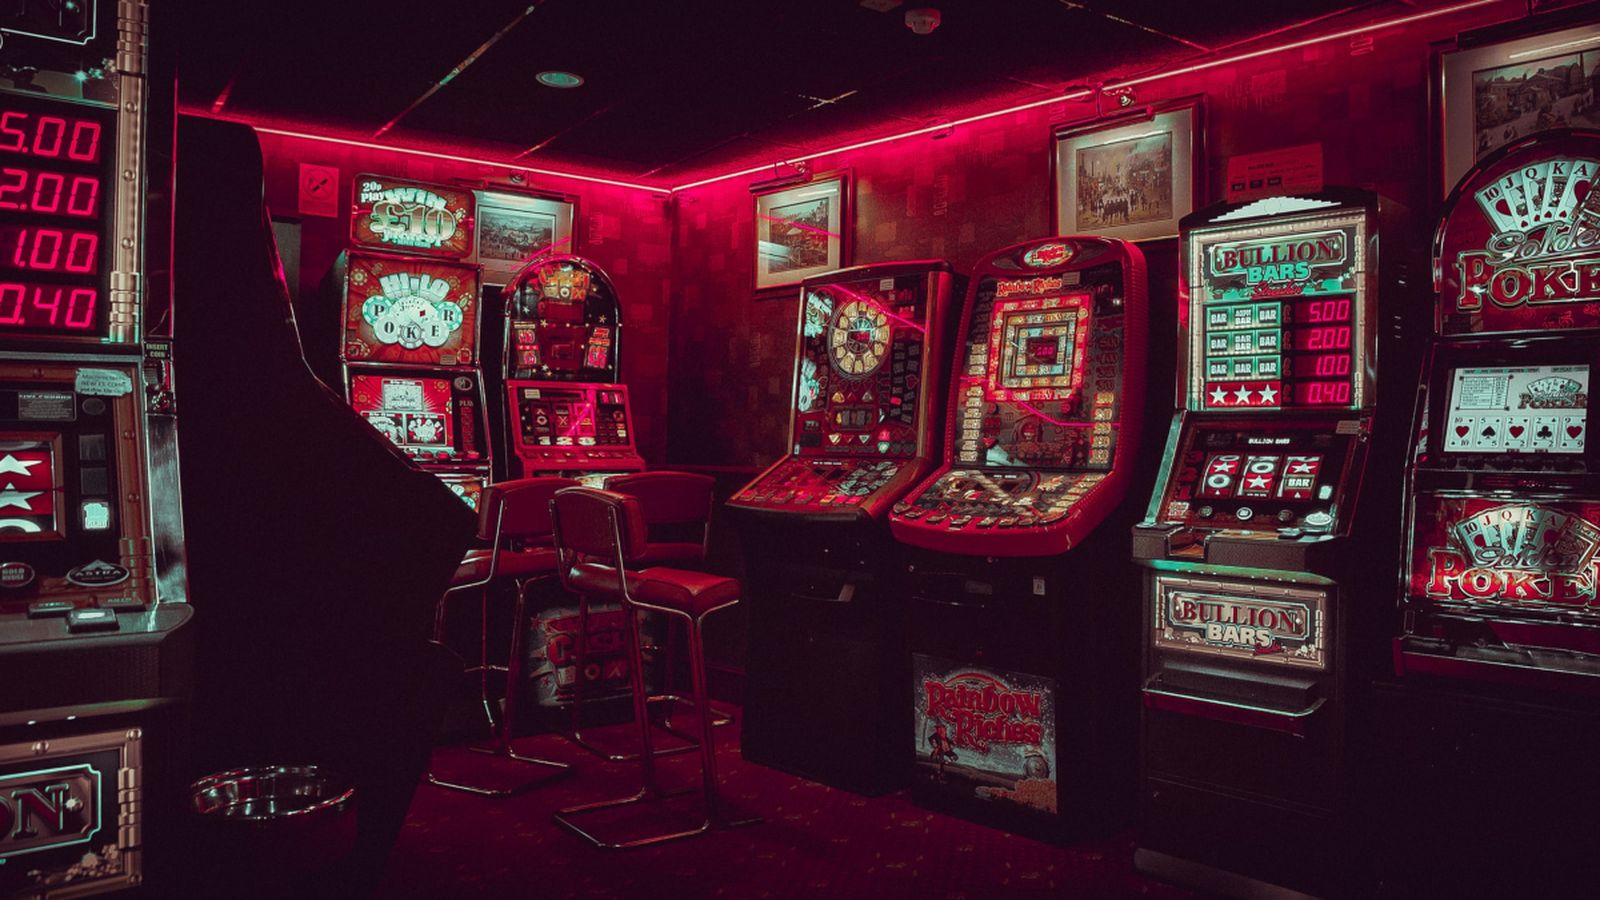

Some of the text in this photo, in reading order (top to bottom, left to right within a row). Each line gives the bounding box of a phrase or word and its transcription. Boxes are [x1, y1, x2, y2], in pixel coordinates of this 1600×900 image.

[0, 112, 101, 162] 5.00
[0, 168, 99, 216] 2.00
[384, 187, 447, 210] WIN
[13, 229, 98, 273] 1.00
[1486, 219, 1600, 265] Golde
[1222, 240, 1337, 268] BULLION
[1247, 261, 1310, 283] BARS
[1211, 313, 1227, 324] BAR
[1259, 310, 1277, 321] BAR
[1309, 301, 1350, 322] 5.00
[1211, 339, 1227, 349] BAR
[1235, 334, 1251, 343] BAR
[1235, 342, 1251, 350] BAR
[1259, 336, 1277, 347] BAR
[1308, 327, 1350, 349] 2.00
[1211, 364, 1227, 375] BAR
[1235, 362, 1251, 373] BAR
[1259, 361, 1276, 372] BAR
[1316, 355, 1350, 376] 1.00
[1308, 382, 1350, 403] 0.40
[1288, 478, 1310, 487] BAR
[1426, 547, 1600, 601] POKE
[1182, 601, 1299, 630] BULLION
[1207, 623, 1272, 646] BARS
[924, 680, 1042, 724] Rainbow
[951, 709, 1043, 757] Riches
